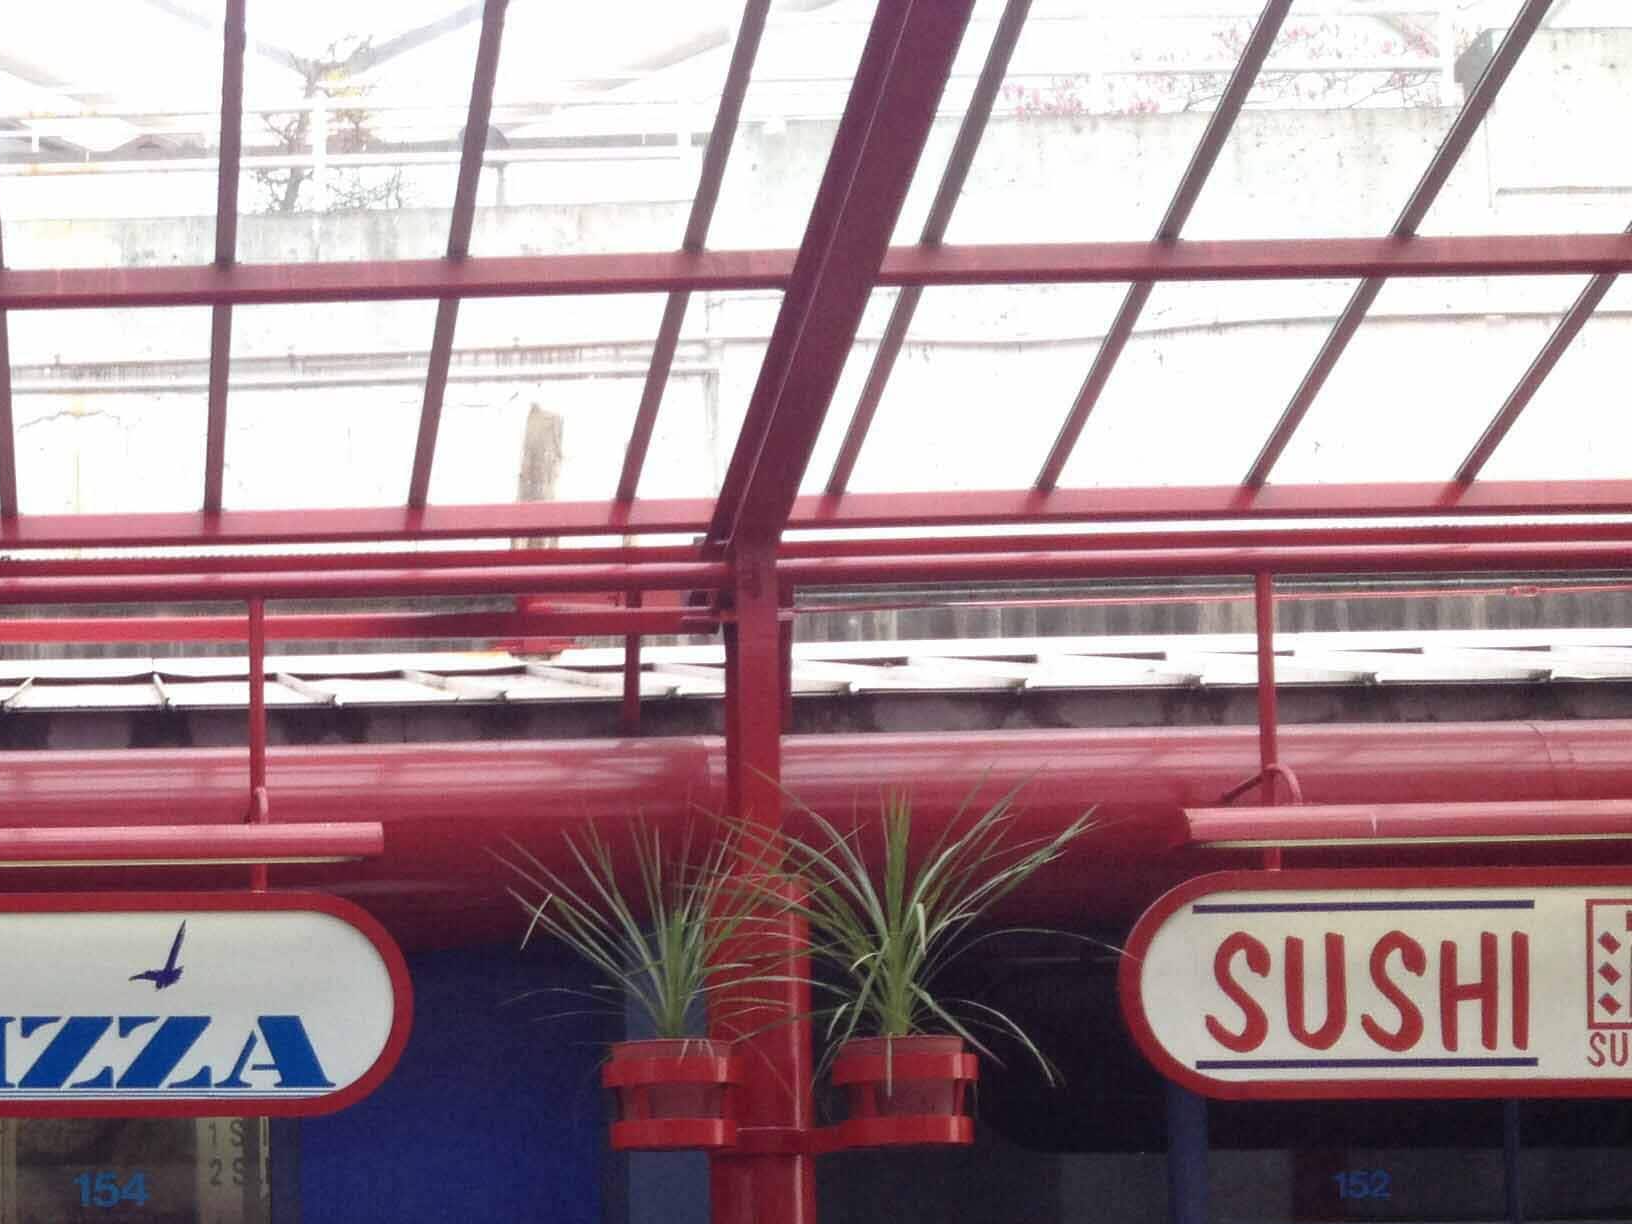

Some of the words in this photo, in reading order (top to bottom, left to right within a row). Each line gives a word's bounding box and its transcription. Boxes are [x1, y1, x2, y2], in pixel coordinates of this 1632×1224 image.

[1205, 930, 1529, 1053] SUSHI
[73, 1172, 149, 1208] 154
[1332, 1170, 1392, 1199] 152
